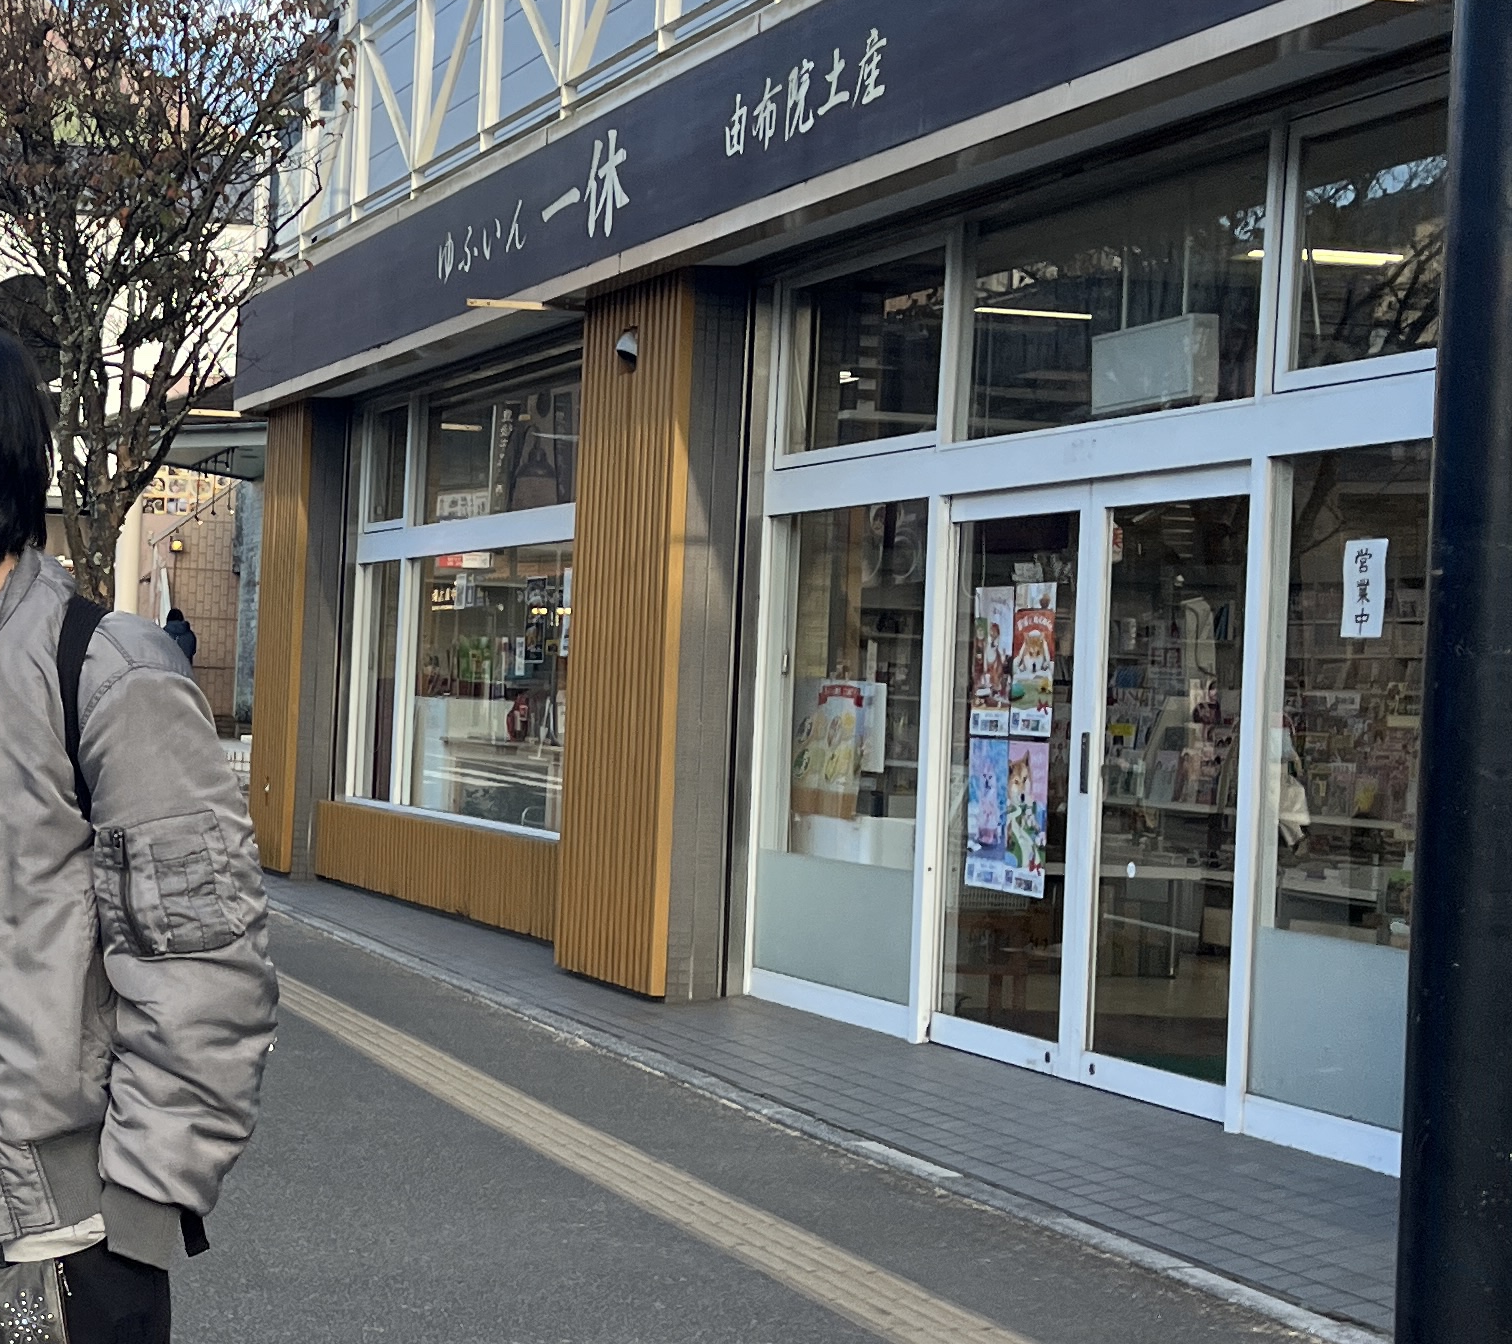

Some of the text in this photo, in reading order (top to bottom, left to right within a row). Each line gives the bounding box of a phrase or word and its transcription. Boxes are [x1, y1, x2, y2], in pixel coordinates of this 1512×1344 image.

[724, 27, 888, 158] 由布院土産
[437, 128, 630, 286] ゆふいん 一休
[1354, 547, 1373, 636] 営業中
